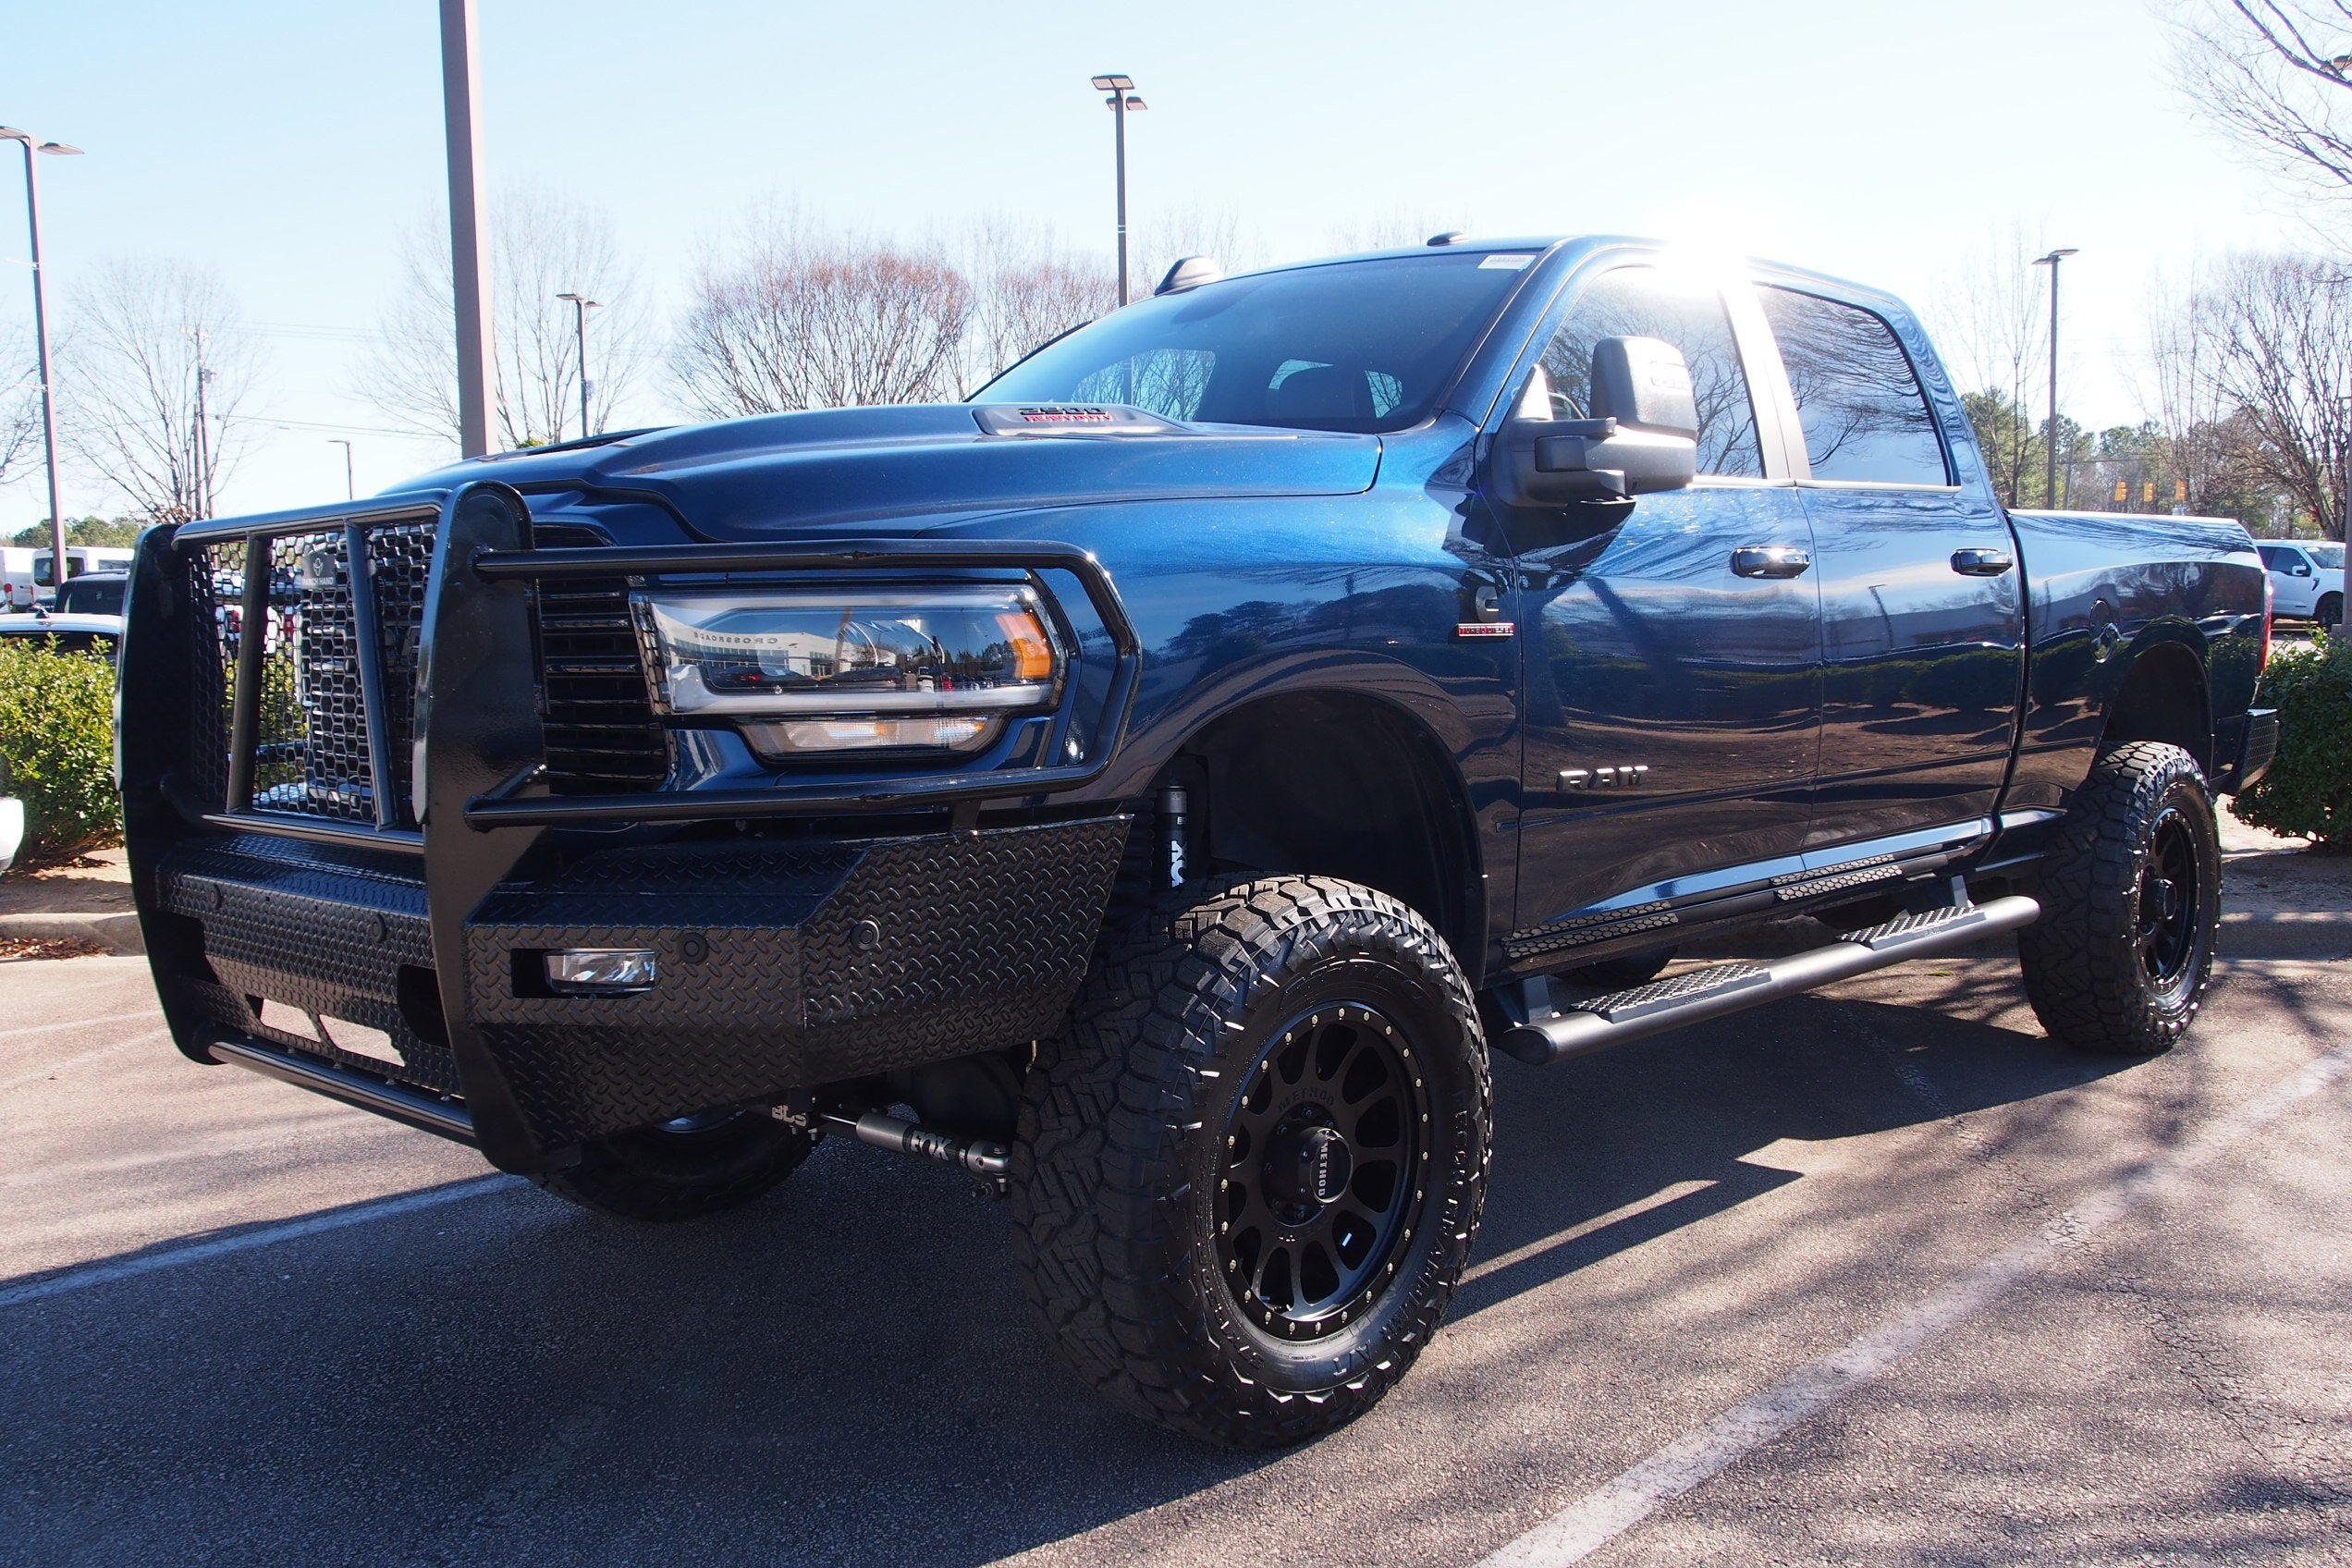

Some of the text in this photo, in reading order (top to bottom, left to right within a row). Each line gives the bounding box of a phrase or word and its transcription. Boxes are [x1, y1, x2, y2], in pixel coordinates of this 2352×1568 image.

[1018, 407, 1109, 416] 2500
[1557, 766, 1648, 790] RAM
[910, 1130, 953, 1161] FOX
[1318, 1141, 1329, 1196] METHOD
